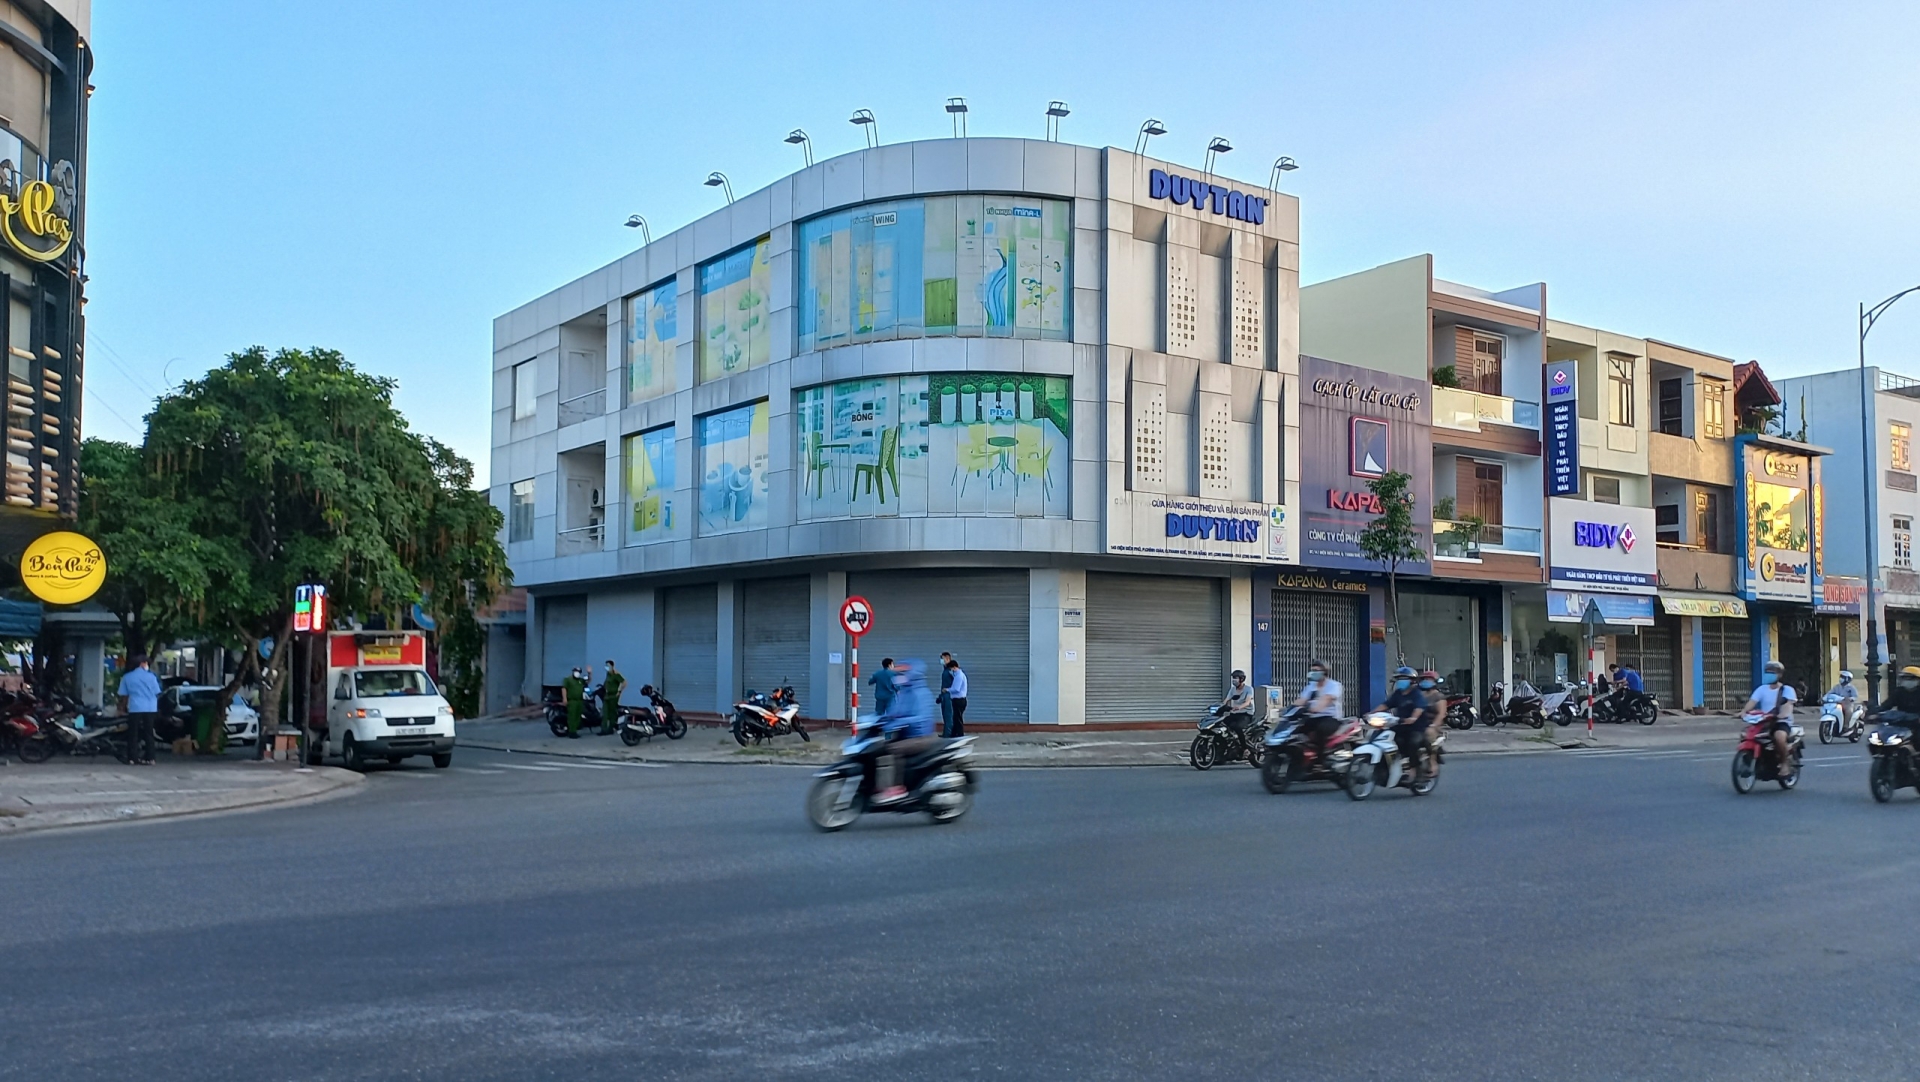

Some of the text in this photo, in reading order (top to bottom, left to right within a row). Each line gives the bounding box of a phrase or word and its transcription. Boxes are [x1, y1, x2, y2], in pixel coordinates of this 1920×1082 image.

[1150, 168, 1265, 225] DUYTAN
[875, 214, 895, 225] WING
[1314, 379, 1421, 410] GẠCH ỐP LÁT CAO CẤP
[1550, 385, 1571, 397] BIDV
[989, 408, 1013, 417] PISA
[1557, 484, 1569, 492] NAM
[1151, 500, 1165, 508] CỬA
[1166, 500, 1184, 510] HÀNG
[1165, 512, 1259, 543] DUYTAN
[1309, 528, 1326, 541] CÔNG
[1326, 532, 1336, 542] TY
[1574, 521, 1618, 549] BIDV
[29, 554, 91, 573] Bon Pas
[1278, 573, 1366, 592] KAPANA Ceramics
[1258, 622, 1268, 631] 147
